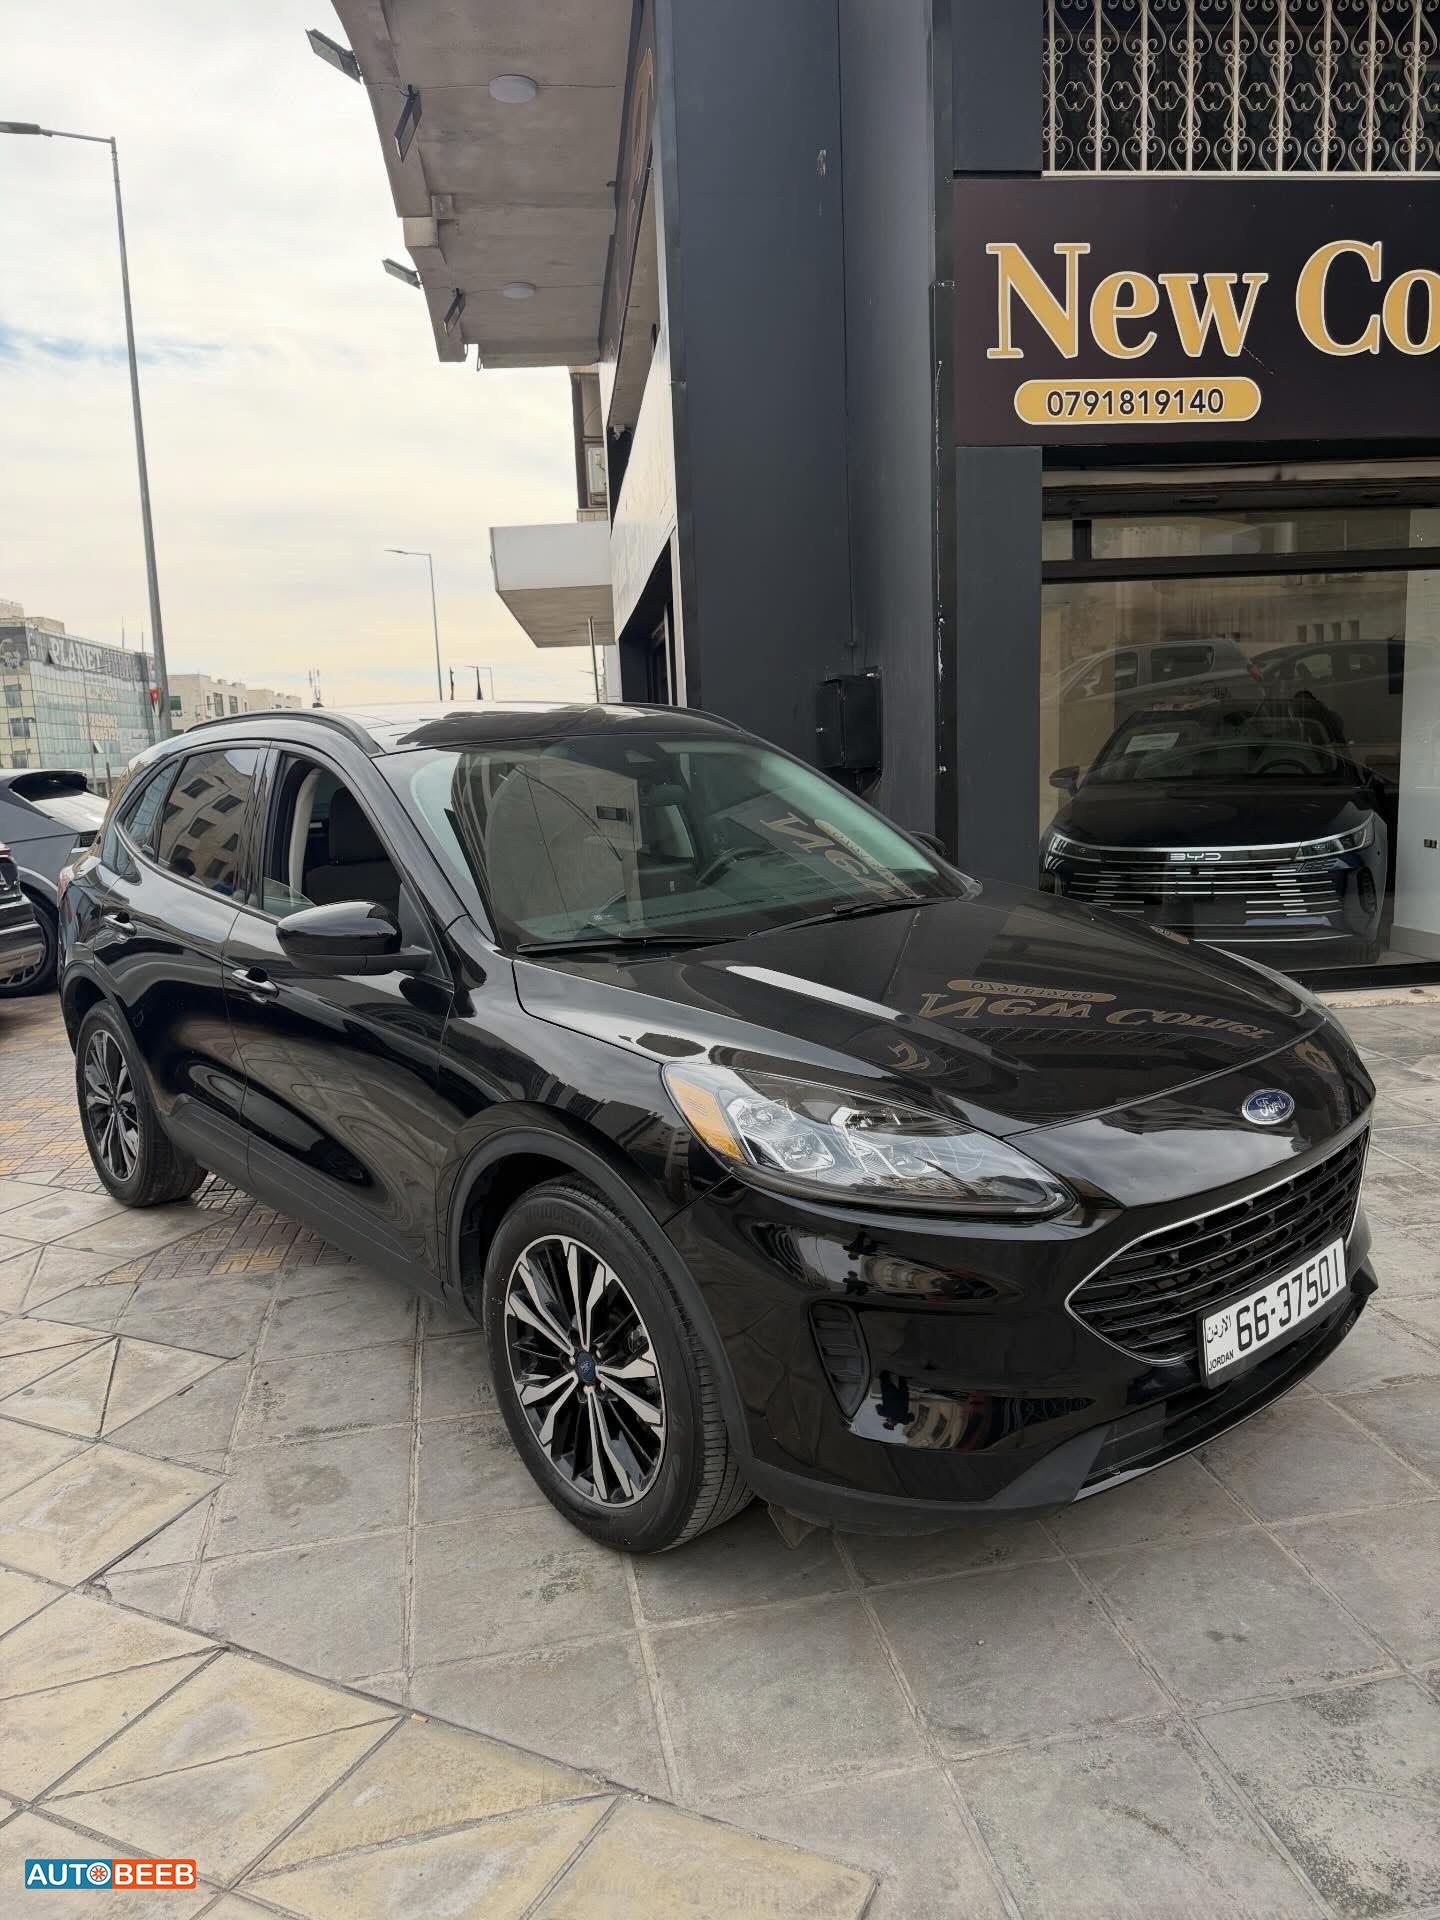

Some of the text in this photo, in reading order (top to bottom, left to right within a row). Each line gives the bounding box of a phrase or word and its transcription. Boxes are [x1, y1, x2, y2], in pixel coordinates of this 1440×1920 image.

[985, 239, 1440, 359] New Co
[1046, 388, 1224, 417] 0791819140
[1170, 852, 1222, 861] BYD
[1255, 1096, 1286, 1117] Ford
[1236, 1248, 1340, 1352] 66-37501
[1208, 1349, 1234, 1371] JORDAN
